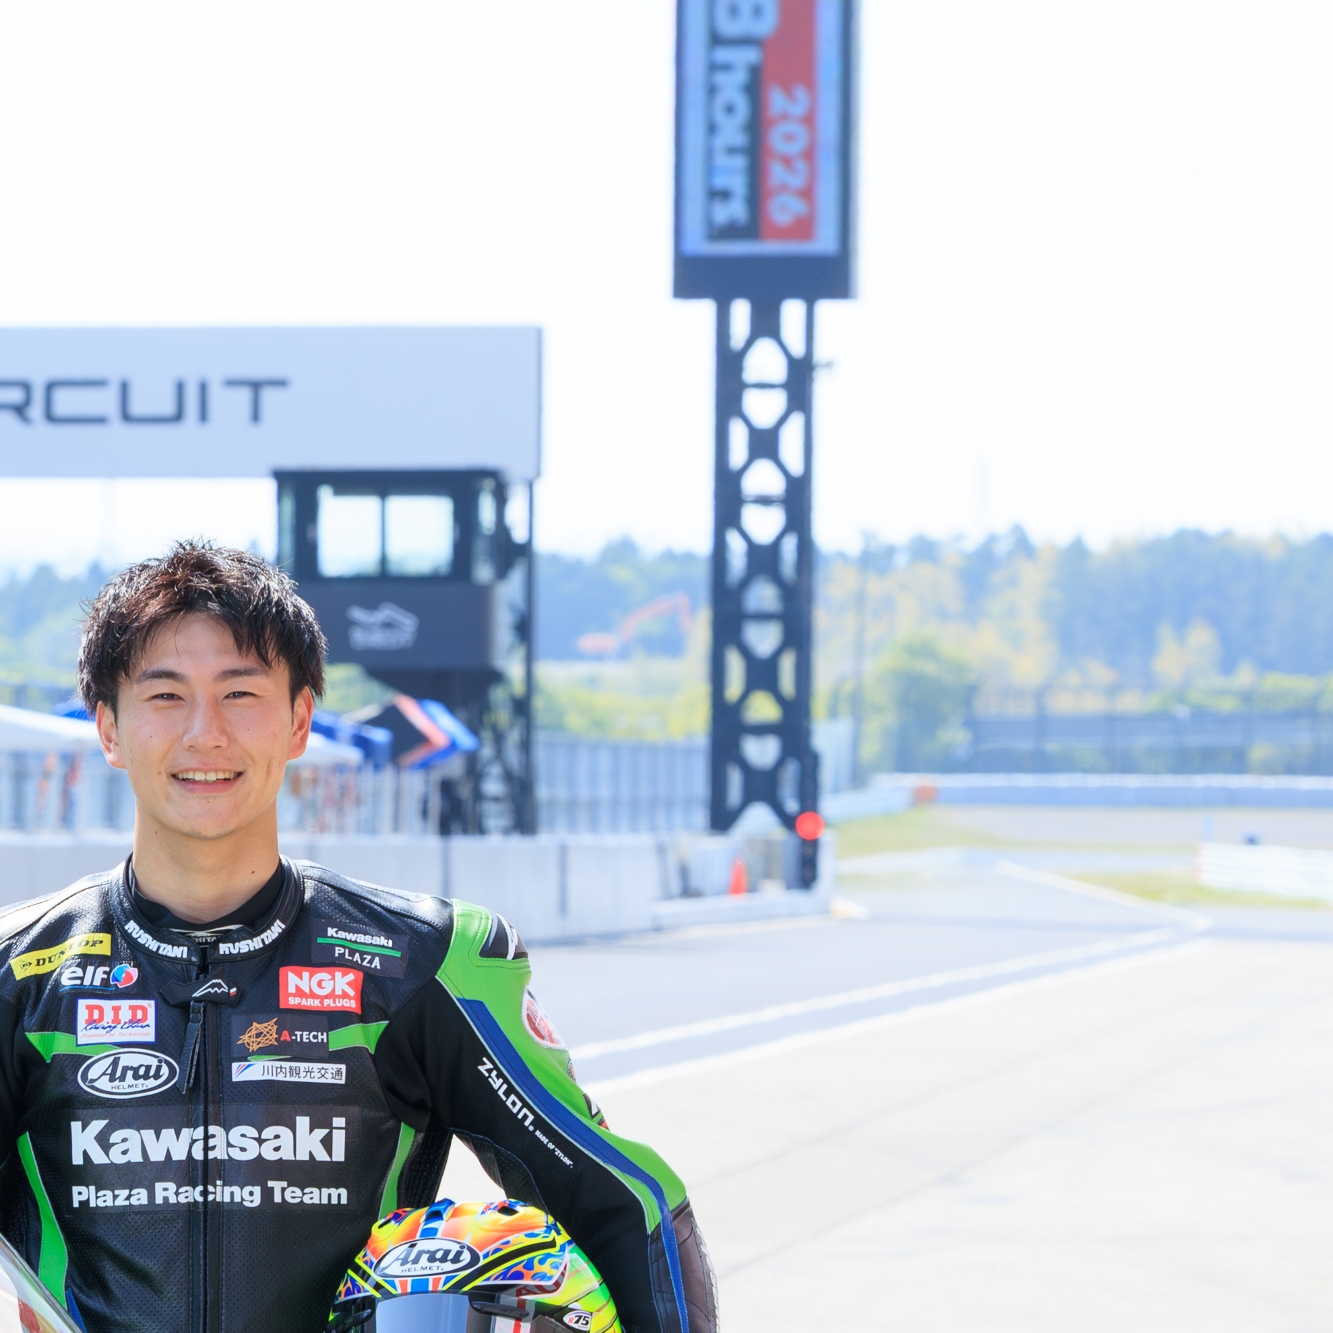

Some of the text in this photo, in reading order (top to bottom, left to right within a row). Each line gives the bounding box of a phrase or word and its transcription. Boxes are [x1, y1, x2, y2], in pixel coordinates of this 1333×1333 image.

[710, 44, 764, 232] hours
[766, 82, 812, 230] 2026
[124, 919, 188, 959] KUSHITANI
[218, 919, 286, 956] KUSHITANI
[326, 926, 393, 948] Kawasaki
[35, 938, 105, 967] DUNLOP
[334, 946, 382, 970] PLAZA
[61, 964, 110, 986] elf
[287, 969, 356, 997] NGK
[85, 1003, 148, 1025] D.I.D
[288, 996, 357, 1009] SPARK PLUGS
[280, 1030, 327, 1043] A-TECH
[87, 1057, 165, 1086] Arai
[261, 1064, 344, 1082] 川内観光交通
[70, 1116, 346, 1166] Kawasaki
[72, 1180, 347, 1208] Plaza Racing Team
[390, 1242, 467, 1268] Arai
[400, 1266, 442, 1274] HELMET
[567, 1314, 591, 1326] R75
